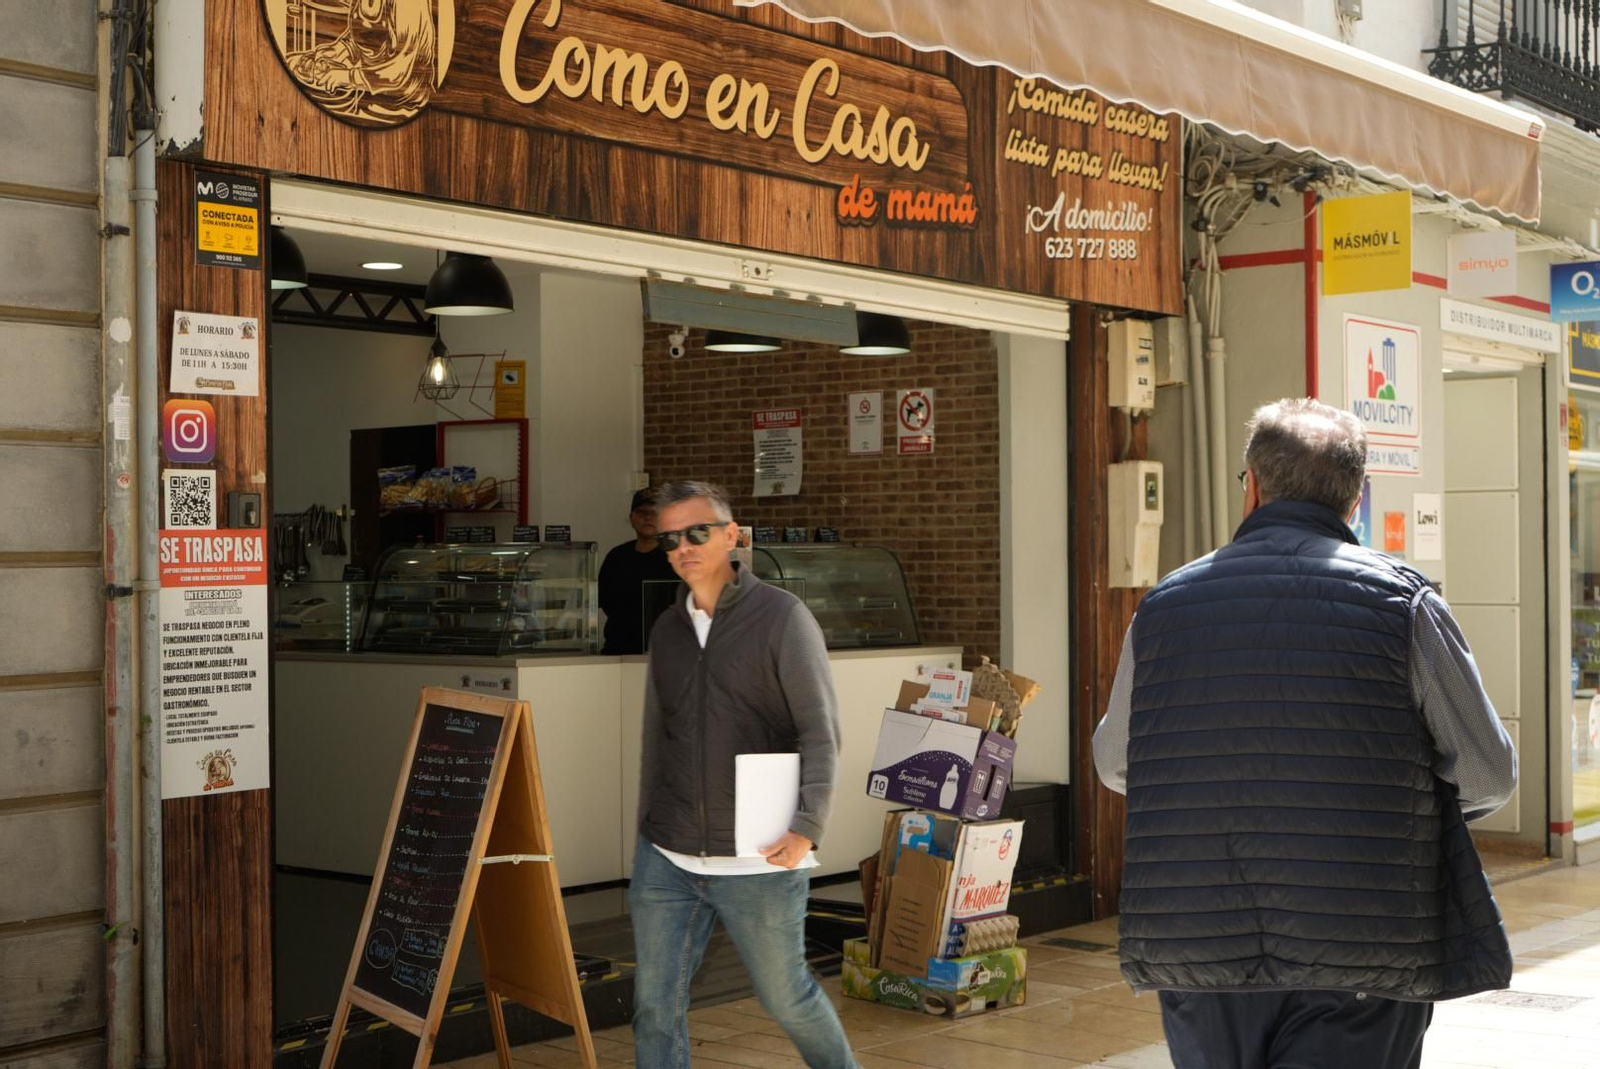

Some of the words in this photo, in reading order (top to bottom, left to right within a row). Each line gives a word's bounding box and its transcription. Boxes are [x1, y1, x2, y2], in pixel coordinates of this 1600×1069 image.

[500, 0, 690, 119] Como
[706, 73, 780, 139] en
[792, 58, 930, 171] Casa
[1104, 106, 1169, 141] casera
[1005, 128, 1050, 166] lista
[1051, 148, 1104, 178] para
[1108, 151, 1169, 191] llevar!
[838, 174, 880, 219] de
[887, 181, 978, 224] mamá
[202, 209, 254, 223] CONECTADA
[1045, 237, 1074, 258] 623
[1077, 238, 1105, 258] 727
[1108, 239, 1137, 259] 888
[1458, 257, 1509, 273] simyo
[197, 325, 234, 336] HORARIO
[1450, 310, 1506, 332] DISTRIBUIDOR
[1508, 323, 1553, 341] MULTIMARCA
[180, 348, 189, 356] DE
[190, 348, 213, 357] LUNES
[214, 350, 219, 358] A
[220, 349, 250, 359] SÁBADO
[181, 359, 191, 367] DE
[193, 360, 207, 368] 11H
[211, 361, 217, 369] A
[222, 361, 247, 370] 15:30H
[1354, 400, 1413, 426] MOVILCITY
[1417, 510, 1438, 525] Lowi
[160, 537, 180, 563] SE
[183, 536, 264, 563] TRASPASA
[184, 589, 243, 601] INTERESADOS
[163, 623, 170, 632] SE
[171, 622, 201, 631] TRASPASA
[201, 621, 225, 630] NEGOCIO
[225, 620, 233, 629] EN
[233, 620, 250, 628] PLENO
[163, 634, 211, 644] FUNCIONAMIENTO
[211, 634, 223, 642] CON
[223, 633, 251, 641] CLIENTELA
[251, 632, 263, 640] FIJA
[163, 649, 167, 657] Y
[168, 648, 199, 657] EXCELENTE
[199, 645, 235, 656] REPUTACIÓN.
[163, 660, 193, 671] UBICACIÓN
[194, 659, 232, 669] INMEJORABLE
[232, 658, 248, 667] PARA
[163, 673, 211, 684] EMPRENDEDORES
[211, 672, 222, 681] QUE
[223, 671, 248, 680] BUSQUEN
[248, 670, 257, 678] UN
[163, 687, 187, 697] NEGOCIO
[188, 686, 215, 696] RENTABLE
[216, 685, 223, 693] EN
[223, 684, 230, 692] EL
[231, 683, 252, 692] SECTOR
[163, 699, 210, 710] GASTRONÓMICO.
[873, 779, 886, 791] 10
